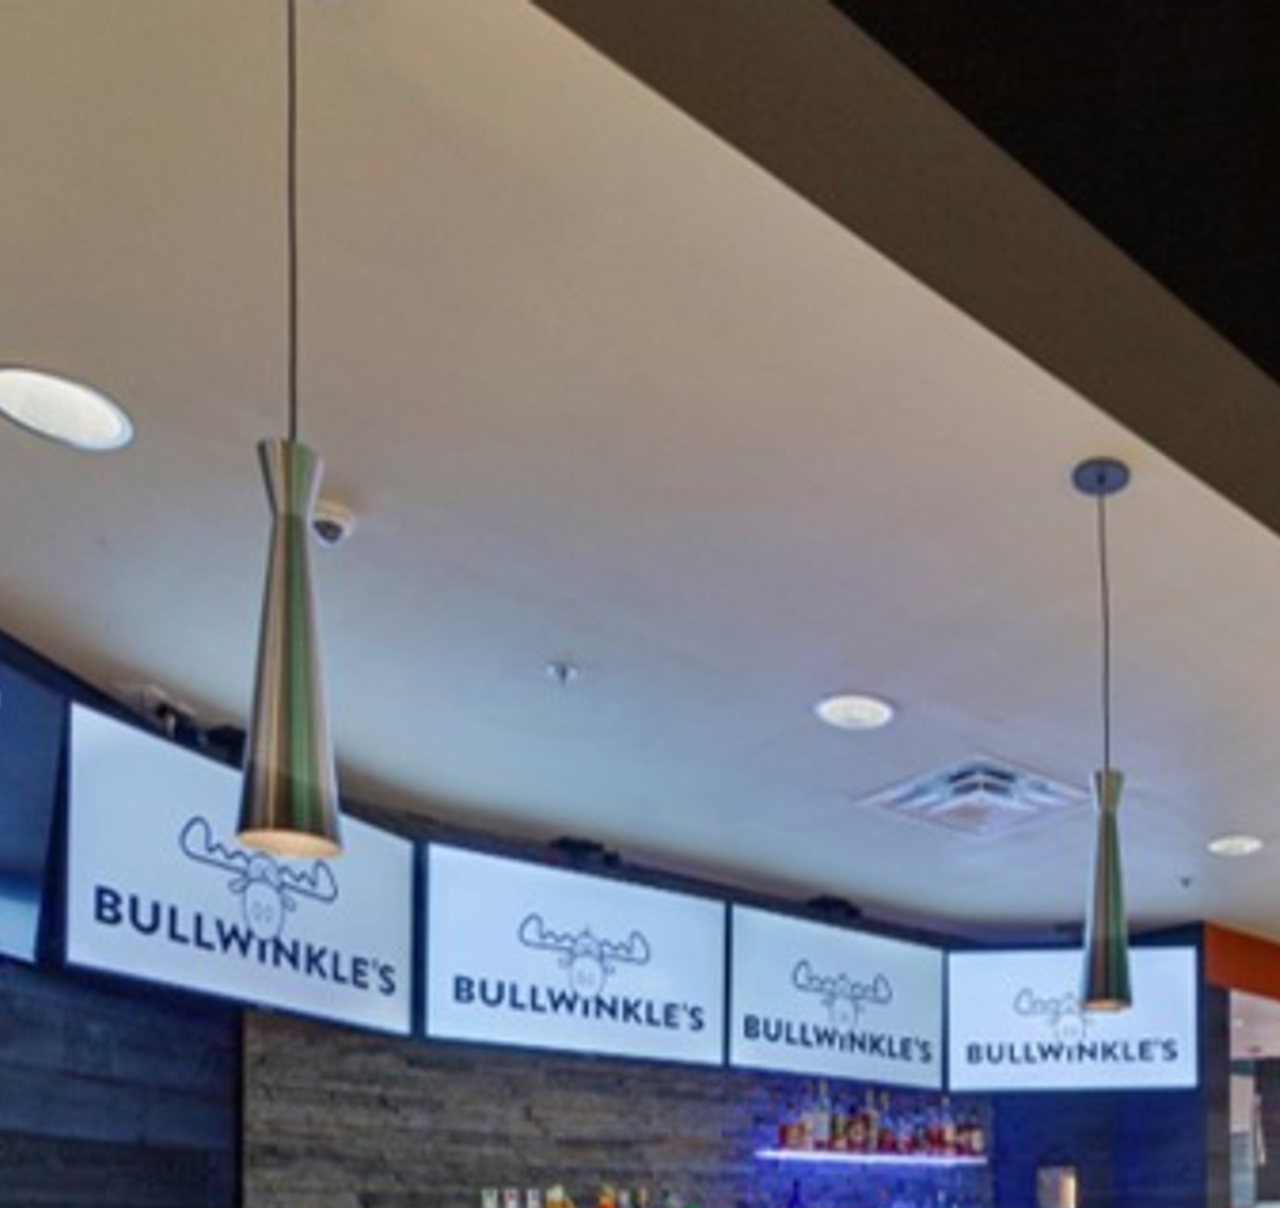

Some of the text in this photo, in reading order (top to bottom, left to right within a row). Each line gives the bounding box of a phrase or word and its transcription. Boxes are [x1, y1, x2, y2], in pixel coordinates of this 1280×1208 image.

[94, 884, 397, 997] BULLWINKLE'S
[453, 975, 705, 1032] BULLWINKLE'S
[743, 1013, 933, 1064] BULLWINKLE'S
[966, 1037, 1179, 1065] BULLWINKLE'S
